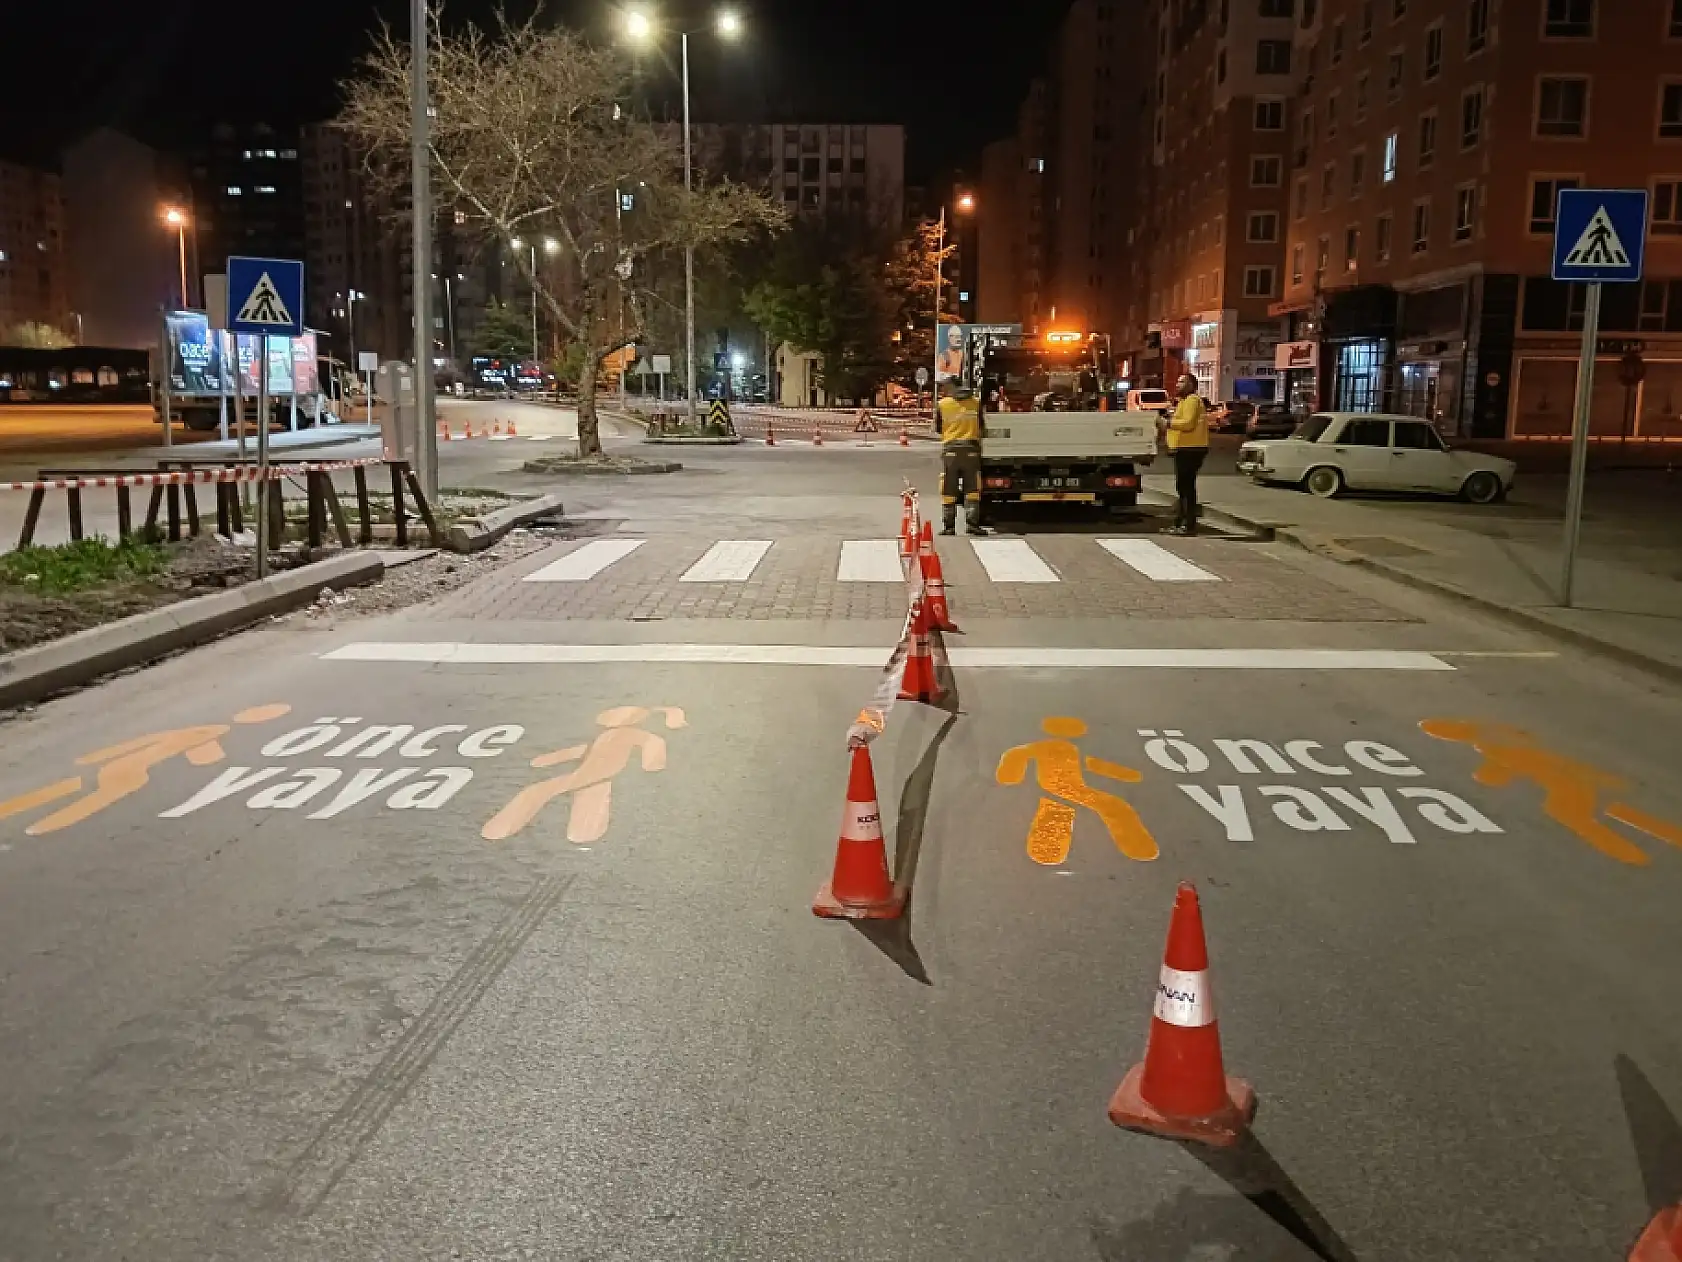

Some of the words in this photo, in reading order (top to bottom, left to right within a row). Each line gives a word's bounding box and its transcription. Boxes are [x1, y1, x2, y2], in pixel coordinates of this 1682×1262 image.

[260, 716, 526, 758] önce
[1136, 728, 1426, 776] önce
[157, 766, 474, 820] yaya
[1176, 783, 1505, 844] yaya
